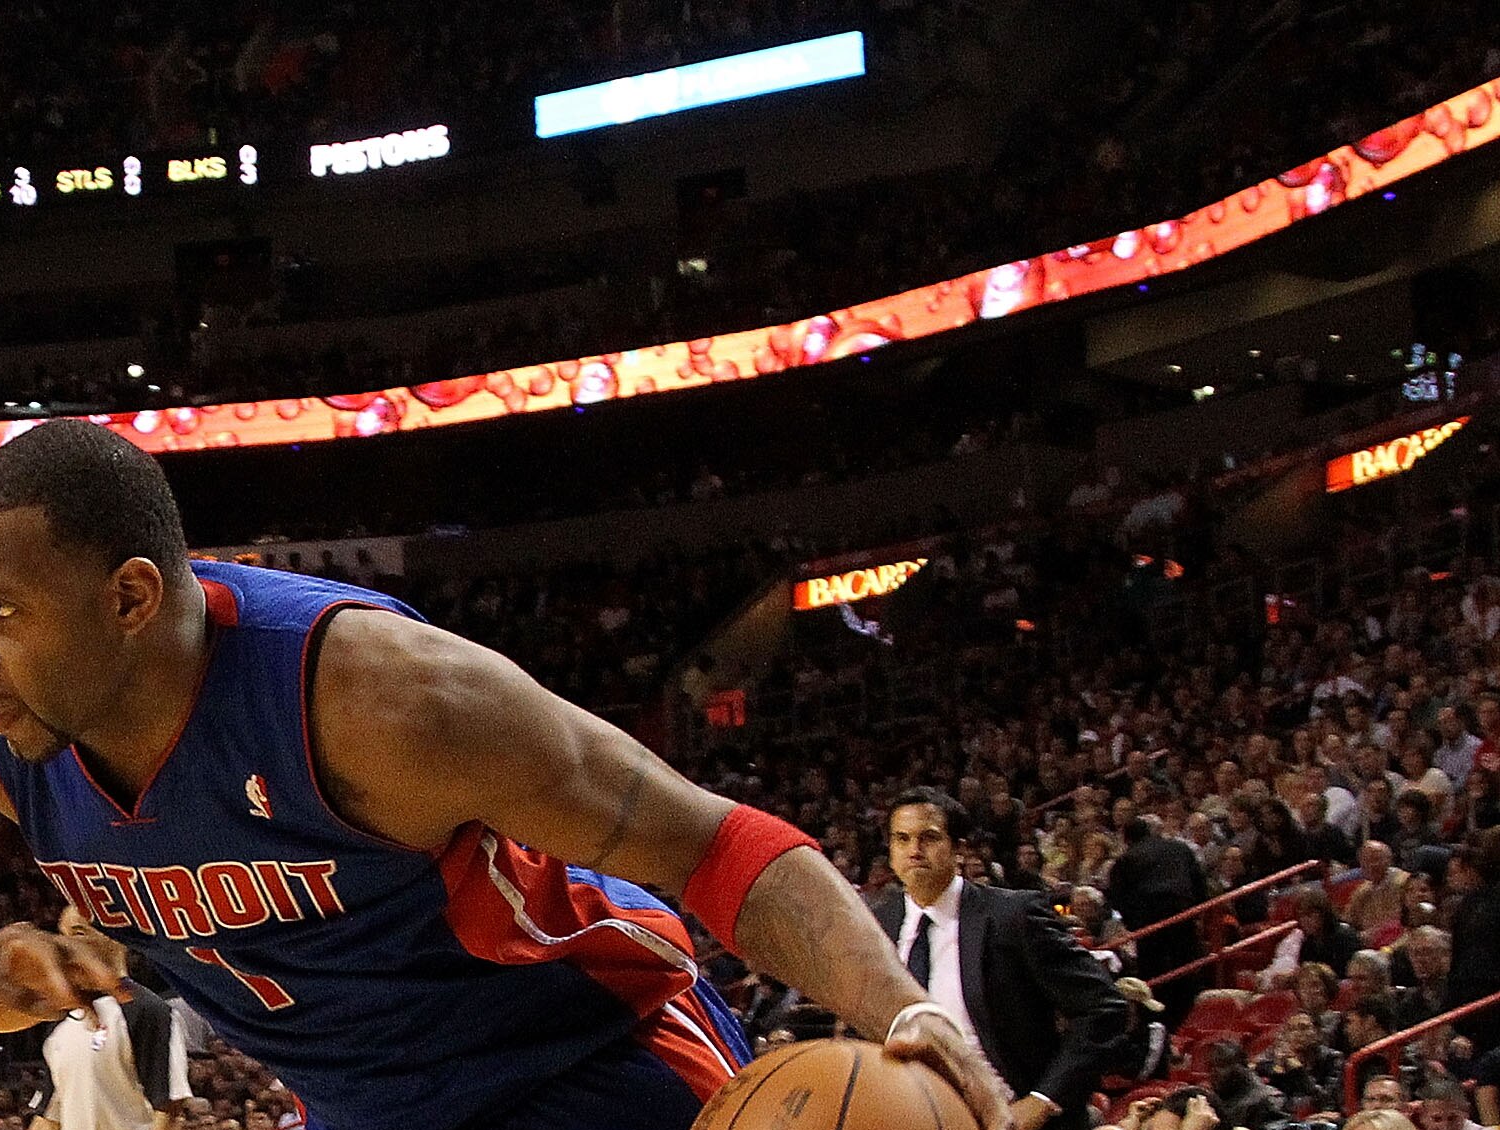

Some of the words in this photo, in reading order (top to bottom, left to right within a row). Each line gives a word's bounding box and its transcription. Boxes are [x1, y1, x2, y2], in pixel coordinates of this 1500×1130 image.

[168, 157, 227, 181] BLKS
[310, 125, 449, 176] PISTONS
[9, 185, 36, 205] 10
[57, 167, 113, 193] STLS
[36, 859, 345, 940] DETROIT
[185, 945, 296, 1012] 1
